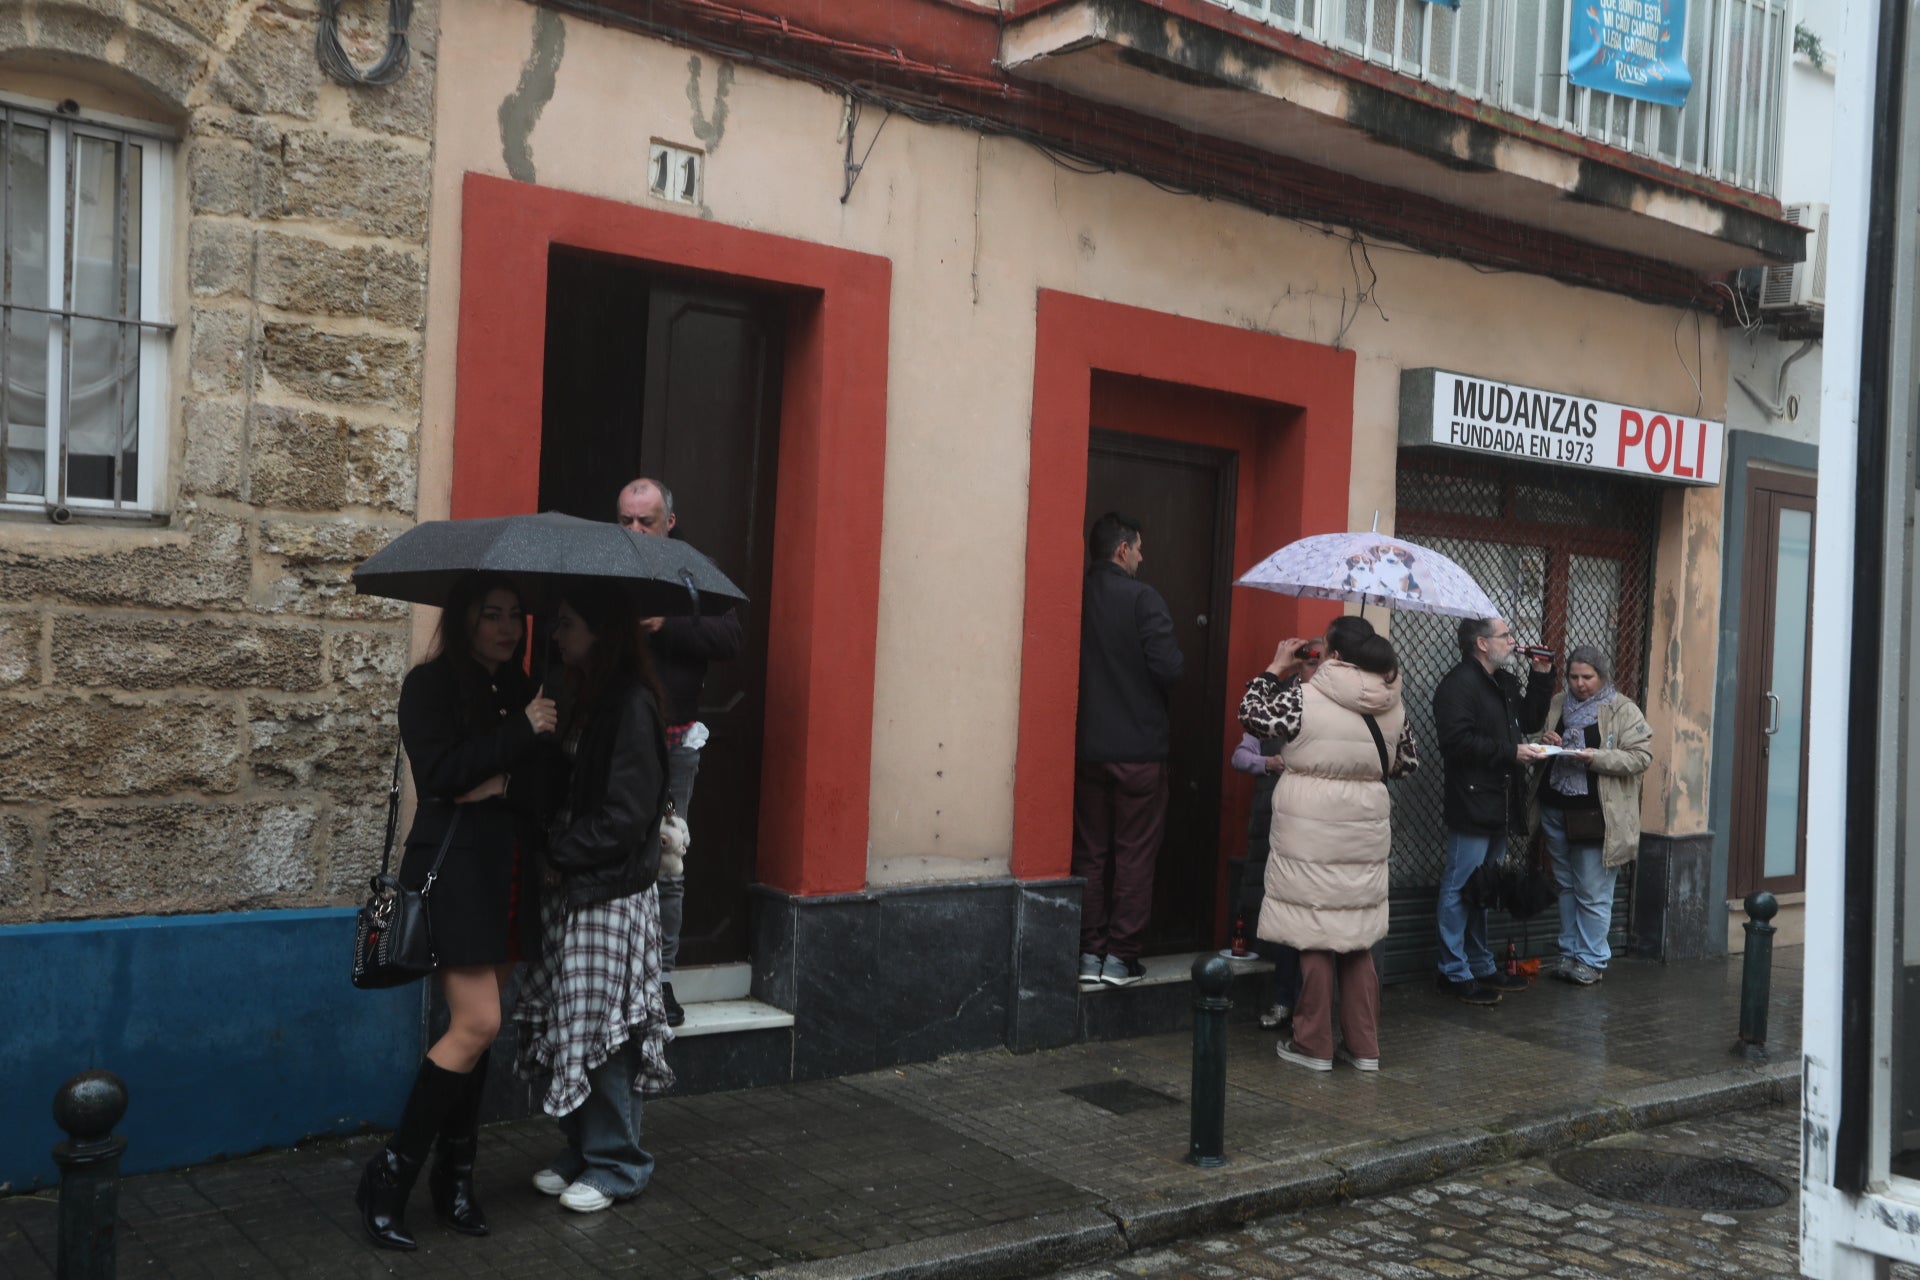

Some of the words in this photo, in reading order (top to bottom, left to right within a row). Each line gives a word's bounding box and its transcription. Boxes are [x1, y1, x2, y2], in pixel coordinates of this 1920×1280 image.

[1603, 10, 1613, 28] MI
[1631, 19, 1659, 42] CUANDO
[1619, 0, 1642, 18] BONITO
[1603, 28, 1621, 50] LLEGA
[1625, 36, 1657, 62] CARNAVAL
[652, 150, 696, 203] 11
[1453, 379, 1597, 438] MUDANZAS
[1450, 422, 1525, 454] FUNDADA
[1530, 434, 1550, 458] EN
[1556, 439, 1594, 464] 1973
[1617, 409, 1707, 479] POLI
